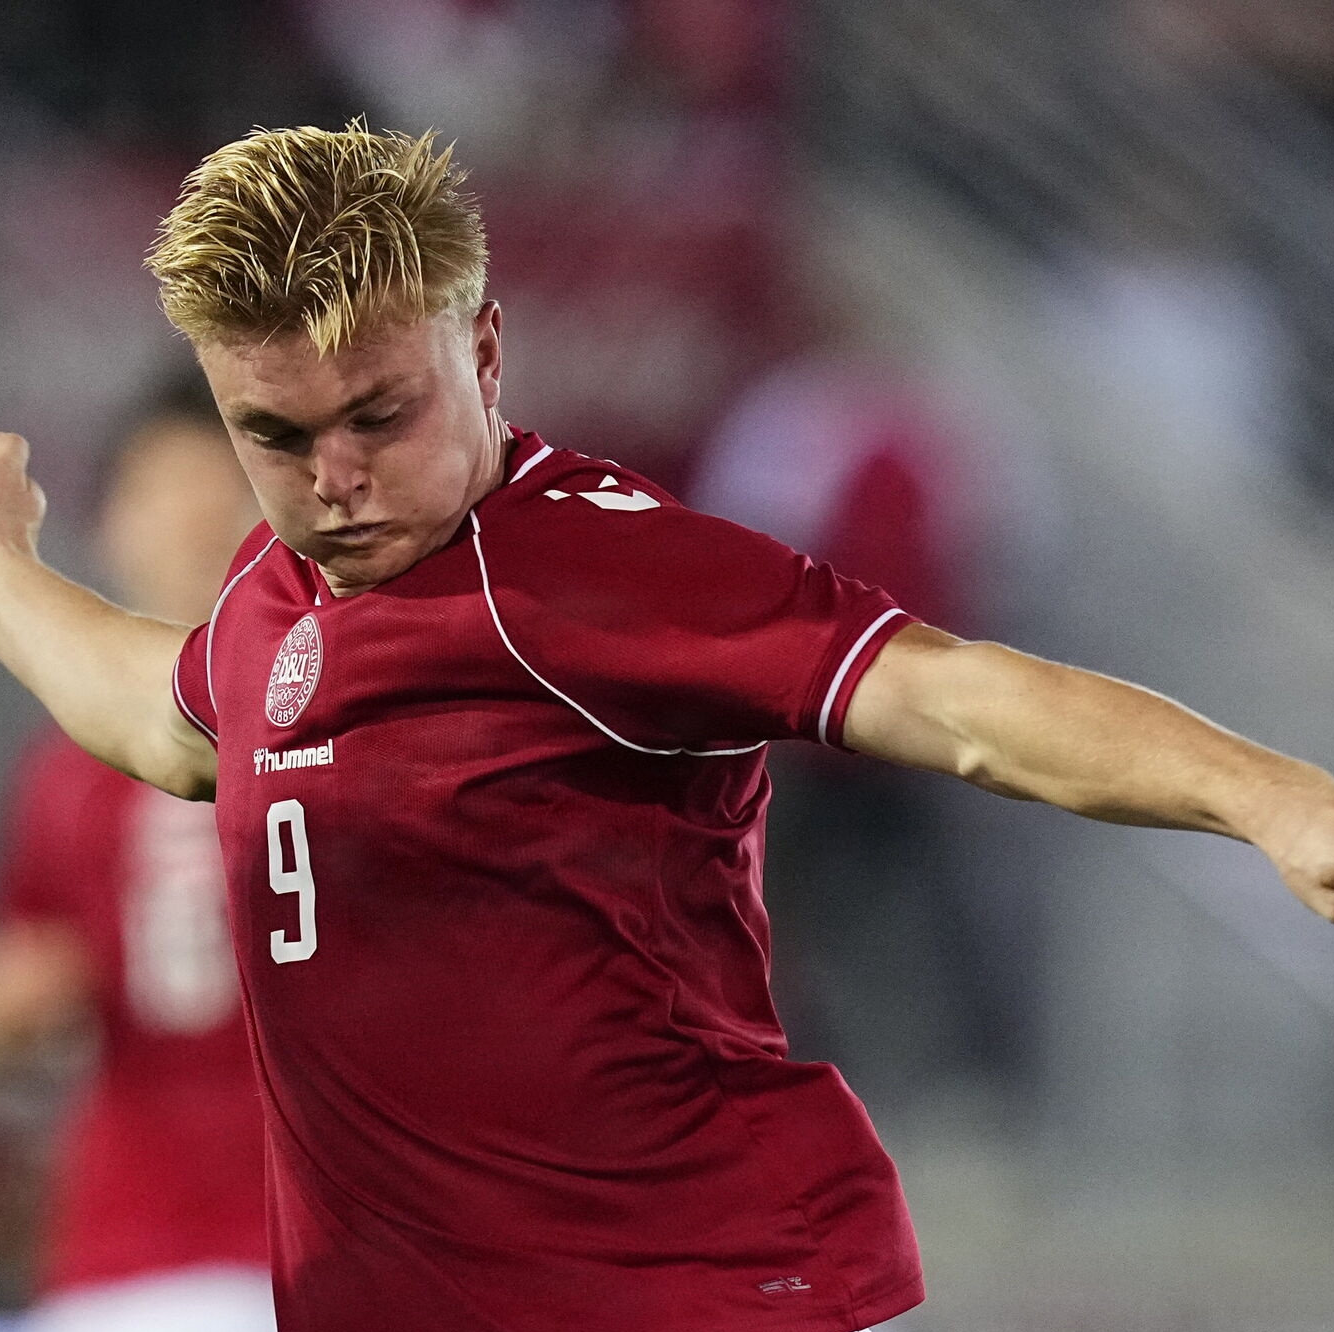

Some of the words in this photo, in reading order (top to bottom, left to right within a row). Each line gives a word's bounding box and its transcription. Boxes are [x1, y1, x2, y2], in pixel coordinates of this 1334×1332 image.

[272, 706, 295, 723] 1889
[264, 738, 334, 773] hummel
[266, 798, 318, 965] 9
